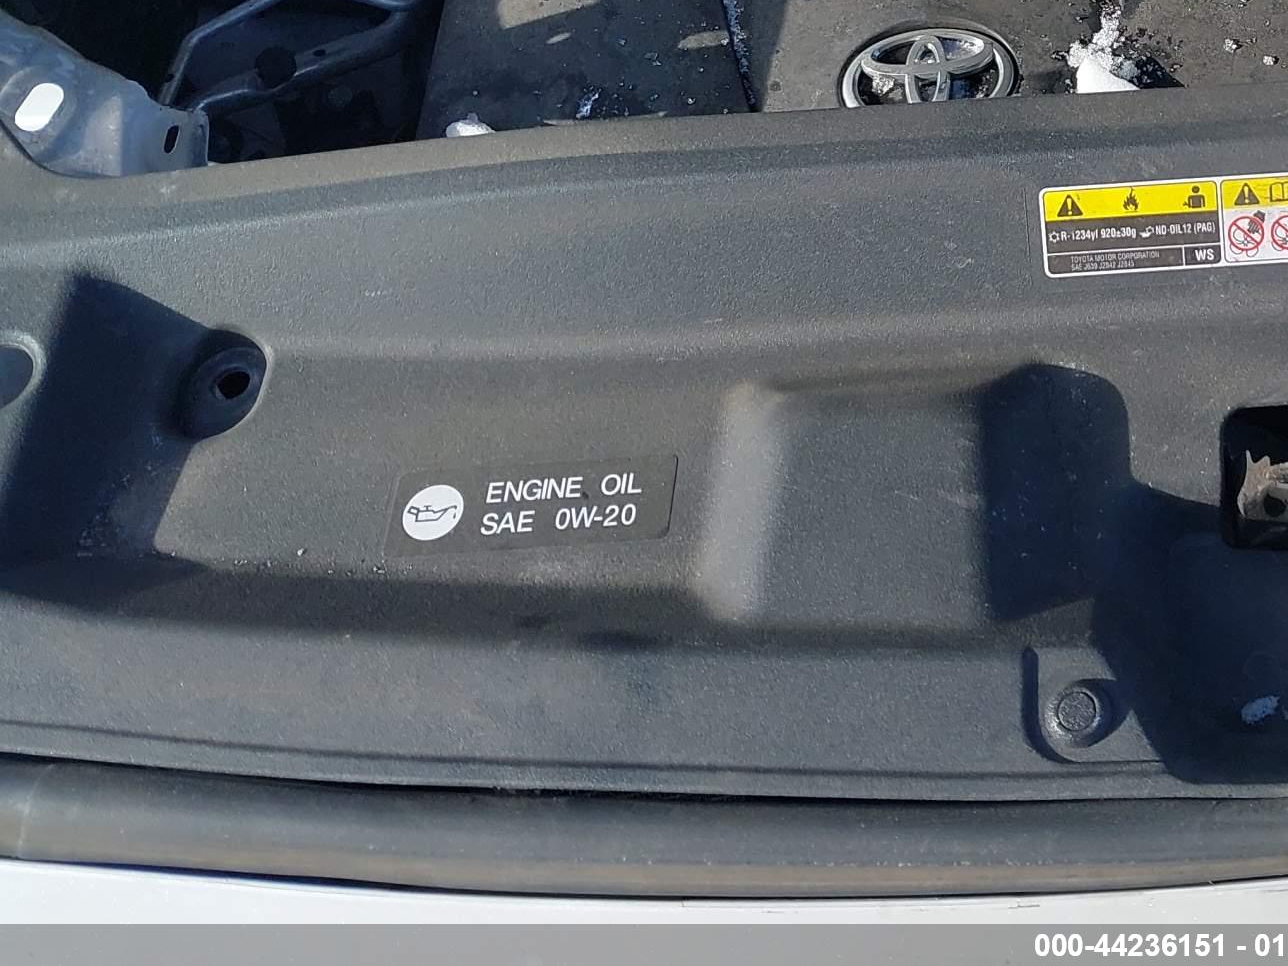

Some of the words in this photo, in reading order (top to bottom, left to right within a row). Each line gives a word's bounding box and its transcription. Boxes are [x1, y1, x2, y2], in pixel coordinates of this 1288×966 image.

[1194, 221, 1216, 234] (PAG)
[1071, 254, 1094, 263] TOYOTA
[1095, 253, 1117, 262] MOTOR
[1118, 251, 1160, 261] CORPORATION
[1195, 248, 1215, 261] WS
[485, 476, 583, 504] ENGINE
[600, 472, 642, 496] OIL
[480, 510, 535, 535] SAE
[554, 503, 637, 531] 0W-20
